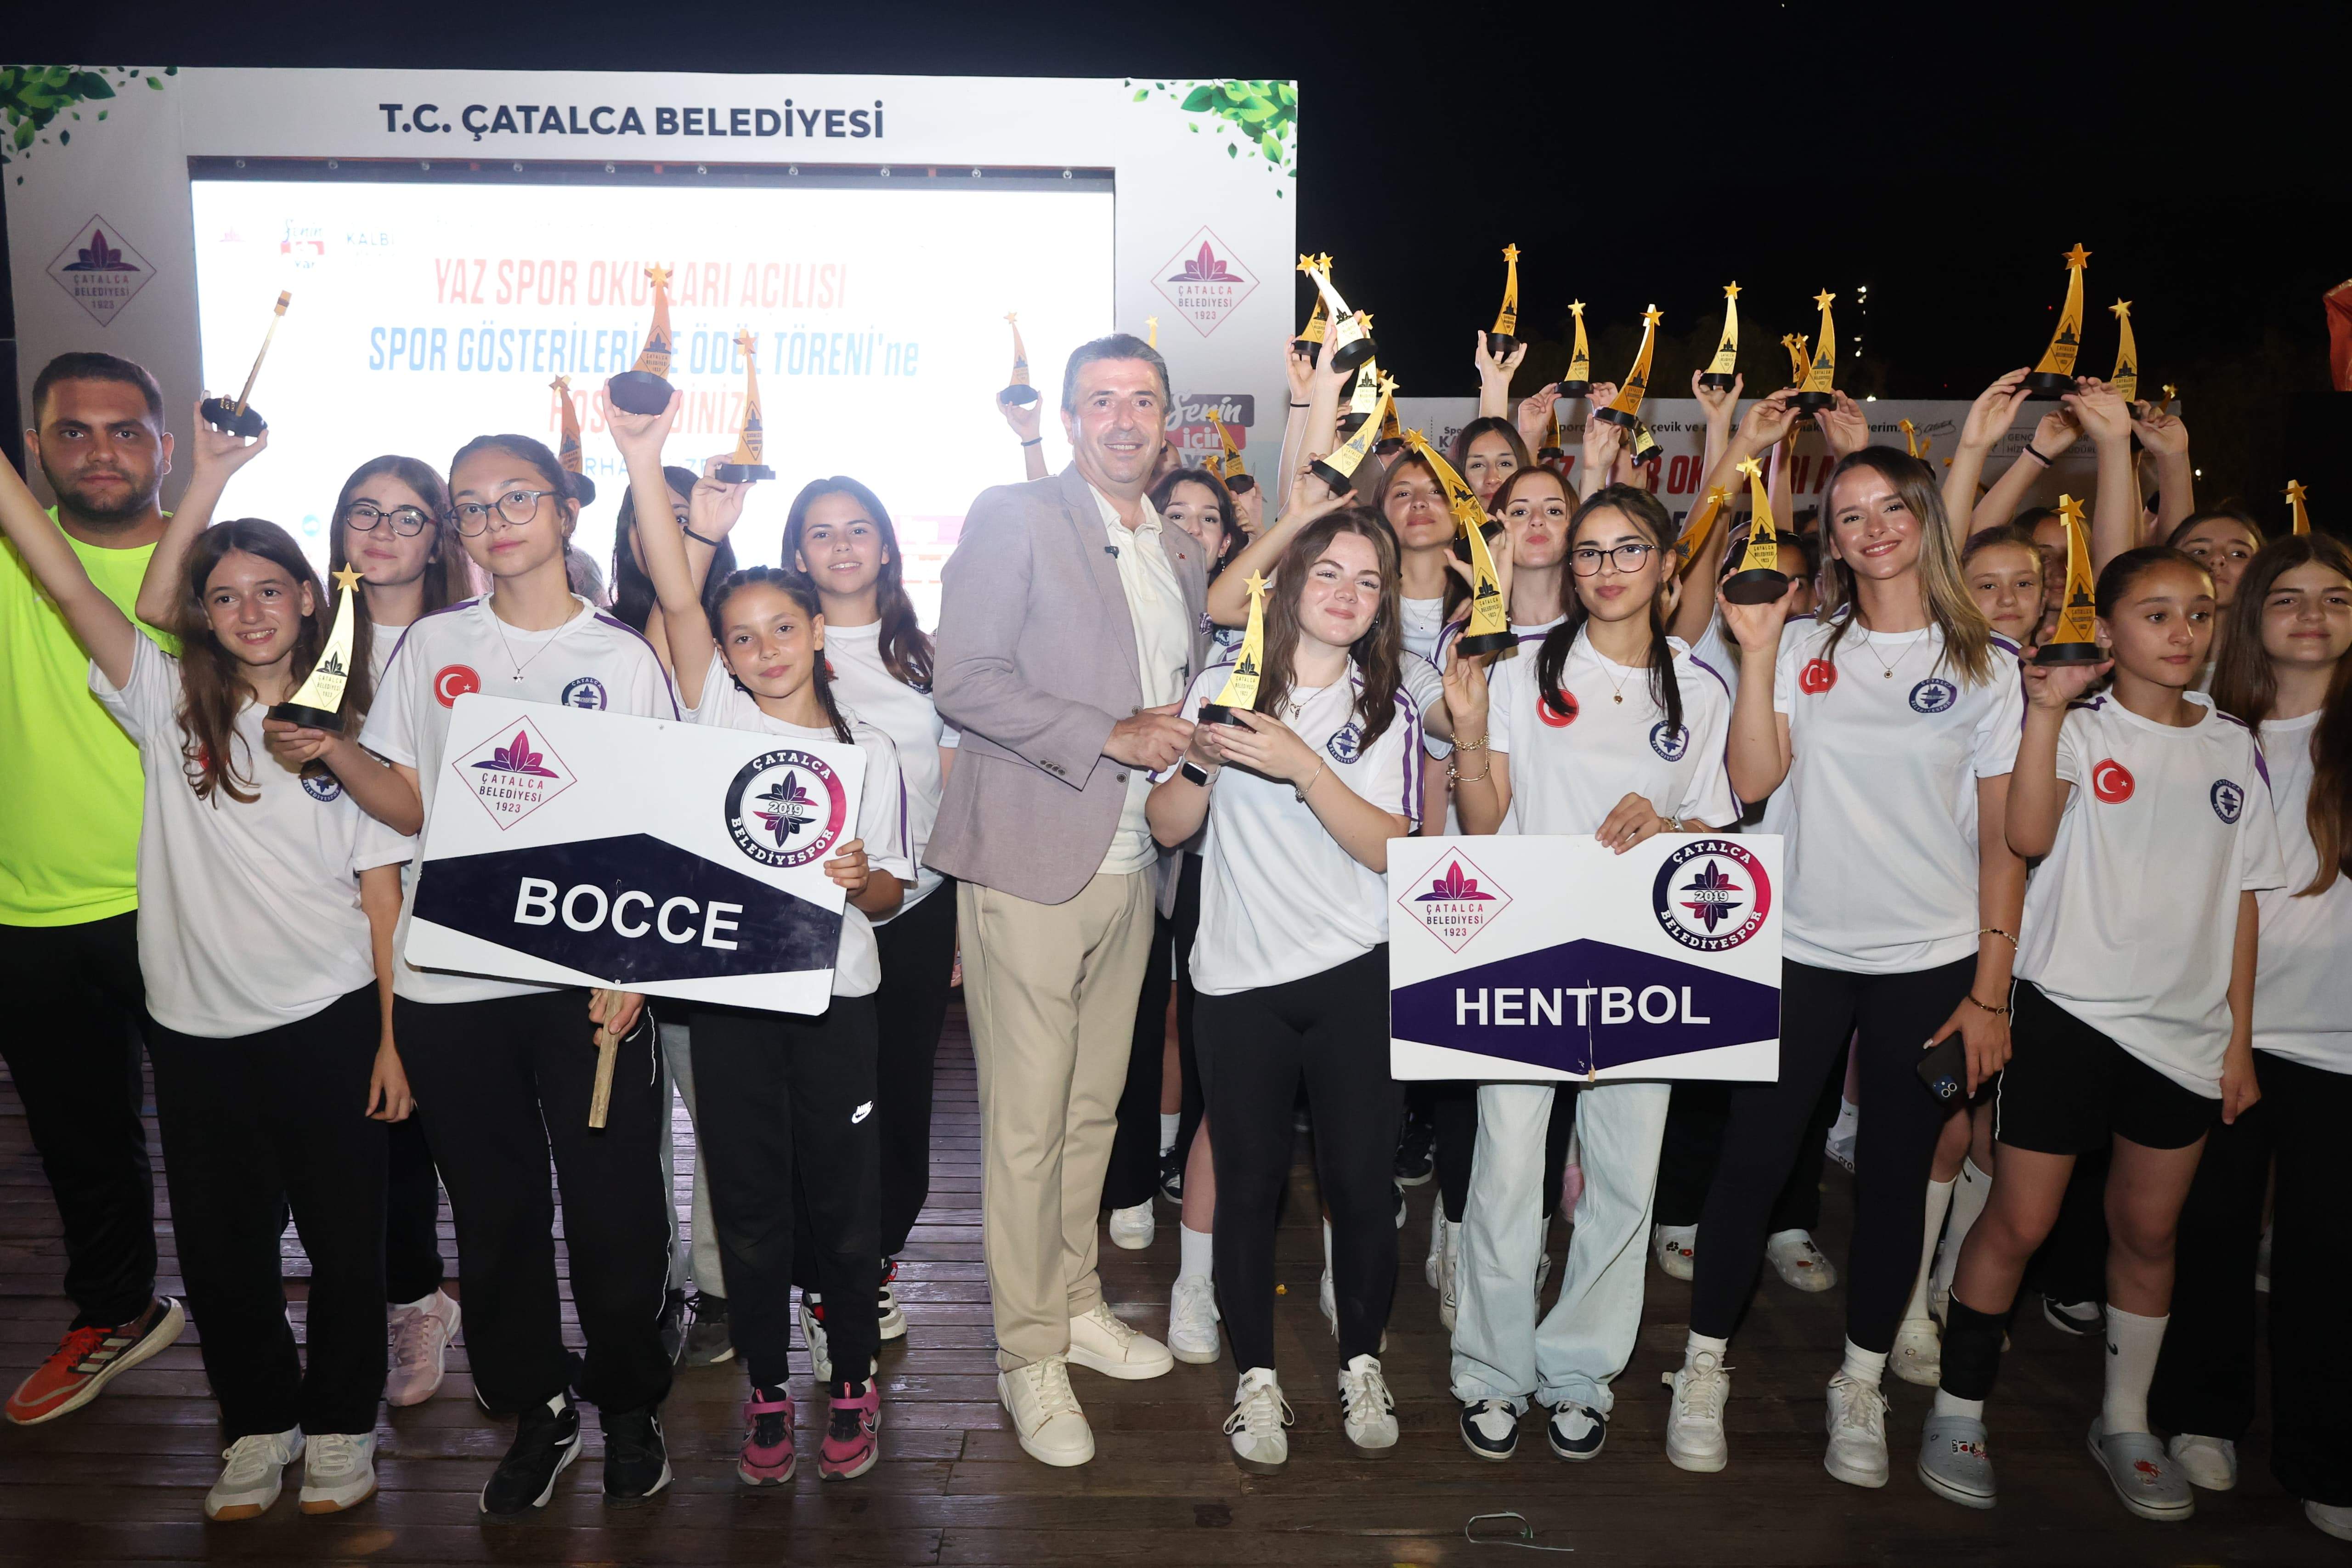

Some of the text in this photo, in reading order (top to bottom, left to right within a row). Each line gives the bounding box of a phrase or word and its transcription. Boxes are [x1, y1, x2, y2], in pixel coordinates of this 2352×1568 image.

[379, 99, 883, 141] T.C. ÇATALCA BELEDİYESİ
[74, 274, 129, 286] ÇATALCA
[435, 258, 486, 305] YAZ
[496, 258, 577, 306] SPOR
[588, 260, 732, 307] OKULARI
[75, 287, 129, 296] BELEDİYESİ
[1179, 286, 1233, 297] ÇATALCA
[91, 300, 114, 309] 1923
[1179, 297, 1232, 307] BELEDİYESİ
[1195, 311, 1216, 319] 1923
[369, 326, 447, 371] SPOR
[458, 320, 639, 373] GÖSTERİLERİ
[775, 323, 919, 377] TÖRENİ'ne
[1651, 421, 1681, 434] çevik
[571, 679, 602, 689] ÇATALCA
[752, 752, 831, 780] ÇATALCA
[482, 773, 543, 789] ÇATALCA
[479, 786, 542, 803] BELEDİYESİ
[496, 802, 520, 813] 1923
[768, 801, 804, 817] 2019
[731, 817, 834, 865] BELEDİYESPOR
[1673, 843, 1751, 864] ÇATALCA
[1694, 892, 1728, 902] 2019
[514, 877, 743, 951] BOCCE
[1427, 904, 1483, 915] ÇATALCA
[1427, 914, 1483, 924] BELEDİYESİ
[1661, 909, 1762, 950] BELEDİYESPOR
[1456, 986, 1710, 1026] HENTBOL
[1838, 1156, 1853, 1170] cro
